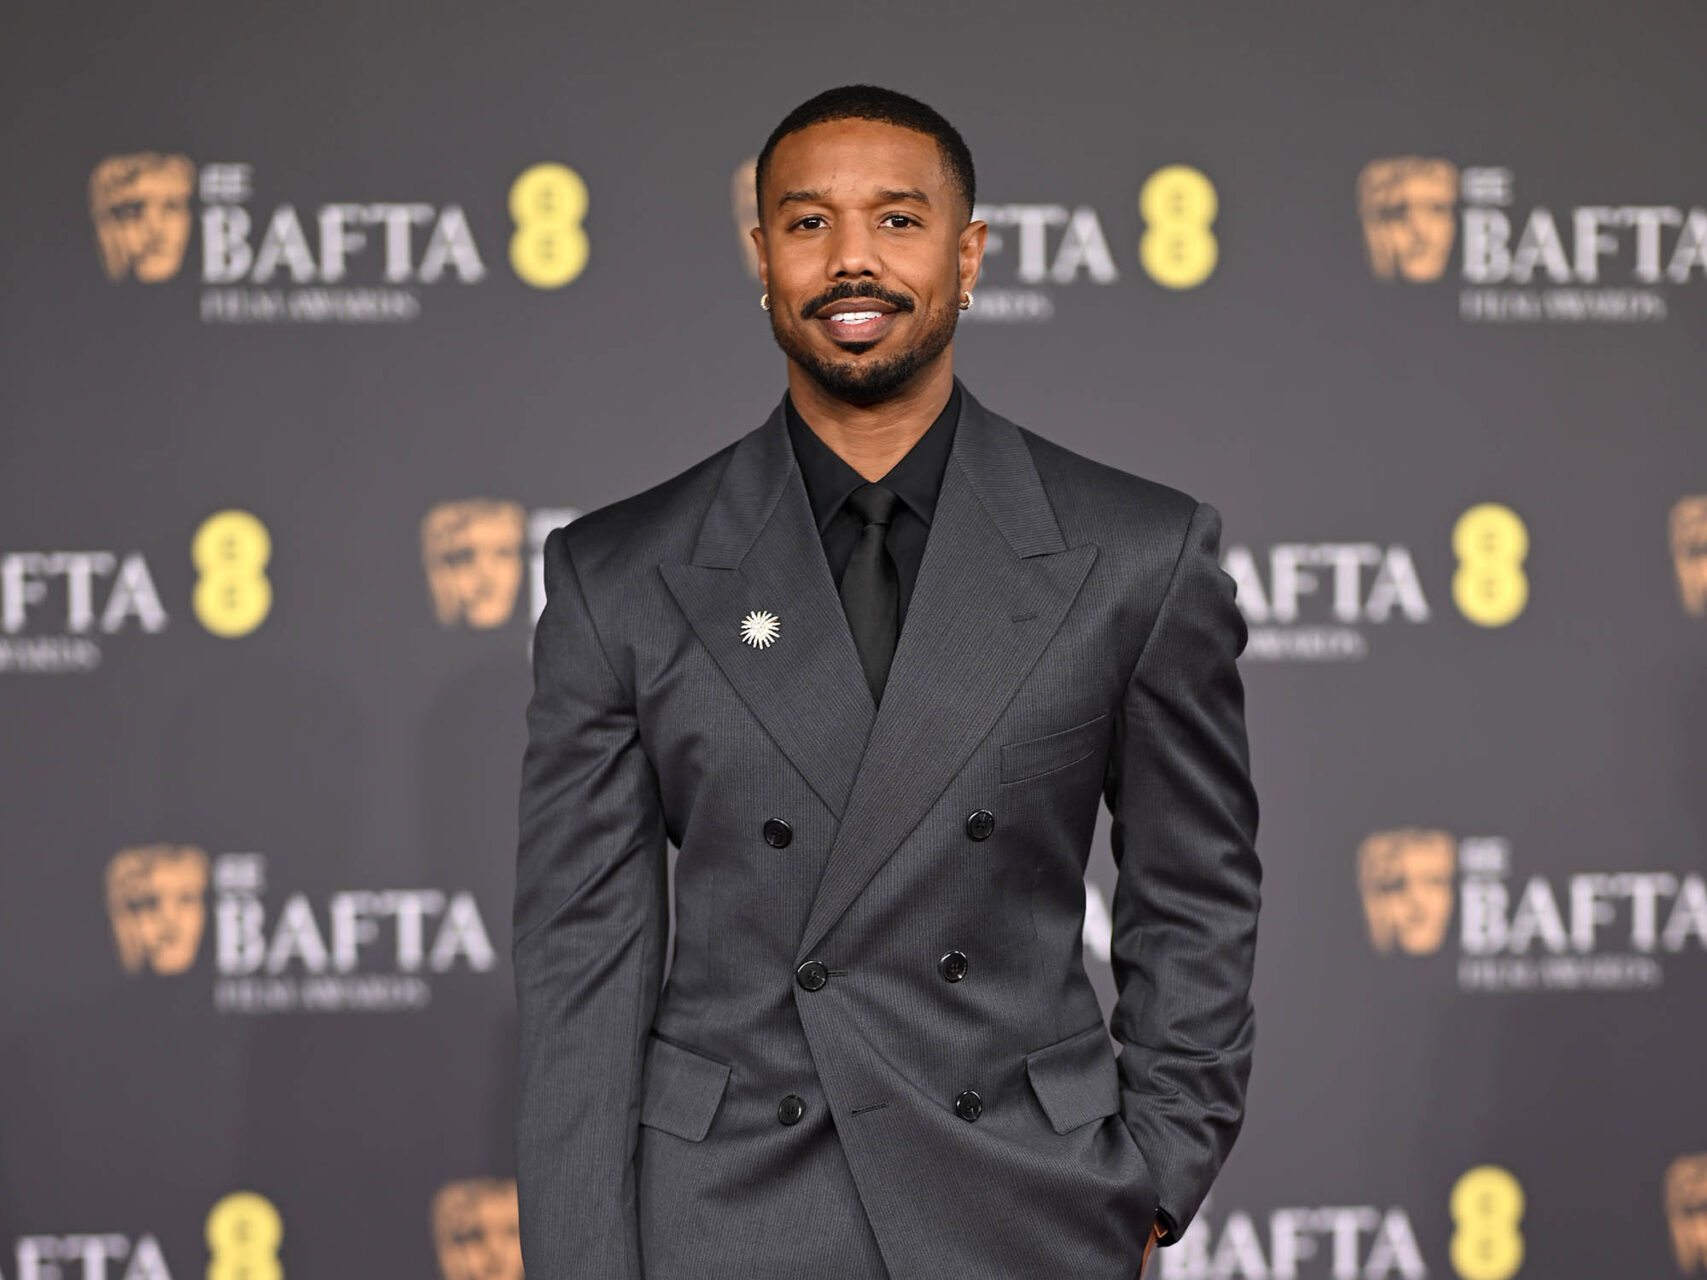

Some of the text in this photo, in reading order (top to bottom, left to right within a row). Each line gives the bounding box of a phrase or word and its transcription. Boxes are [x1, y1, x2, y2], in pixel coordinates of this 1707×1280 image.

[201, 202, 485, 284] BAFTA
[1462, 204, 1707, 284] BAFTA
[0, 551, 168, 634] FTA
[216, 889, 496, 975] BAFTA
[1460, 872, 1707, 955] BAFTA
